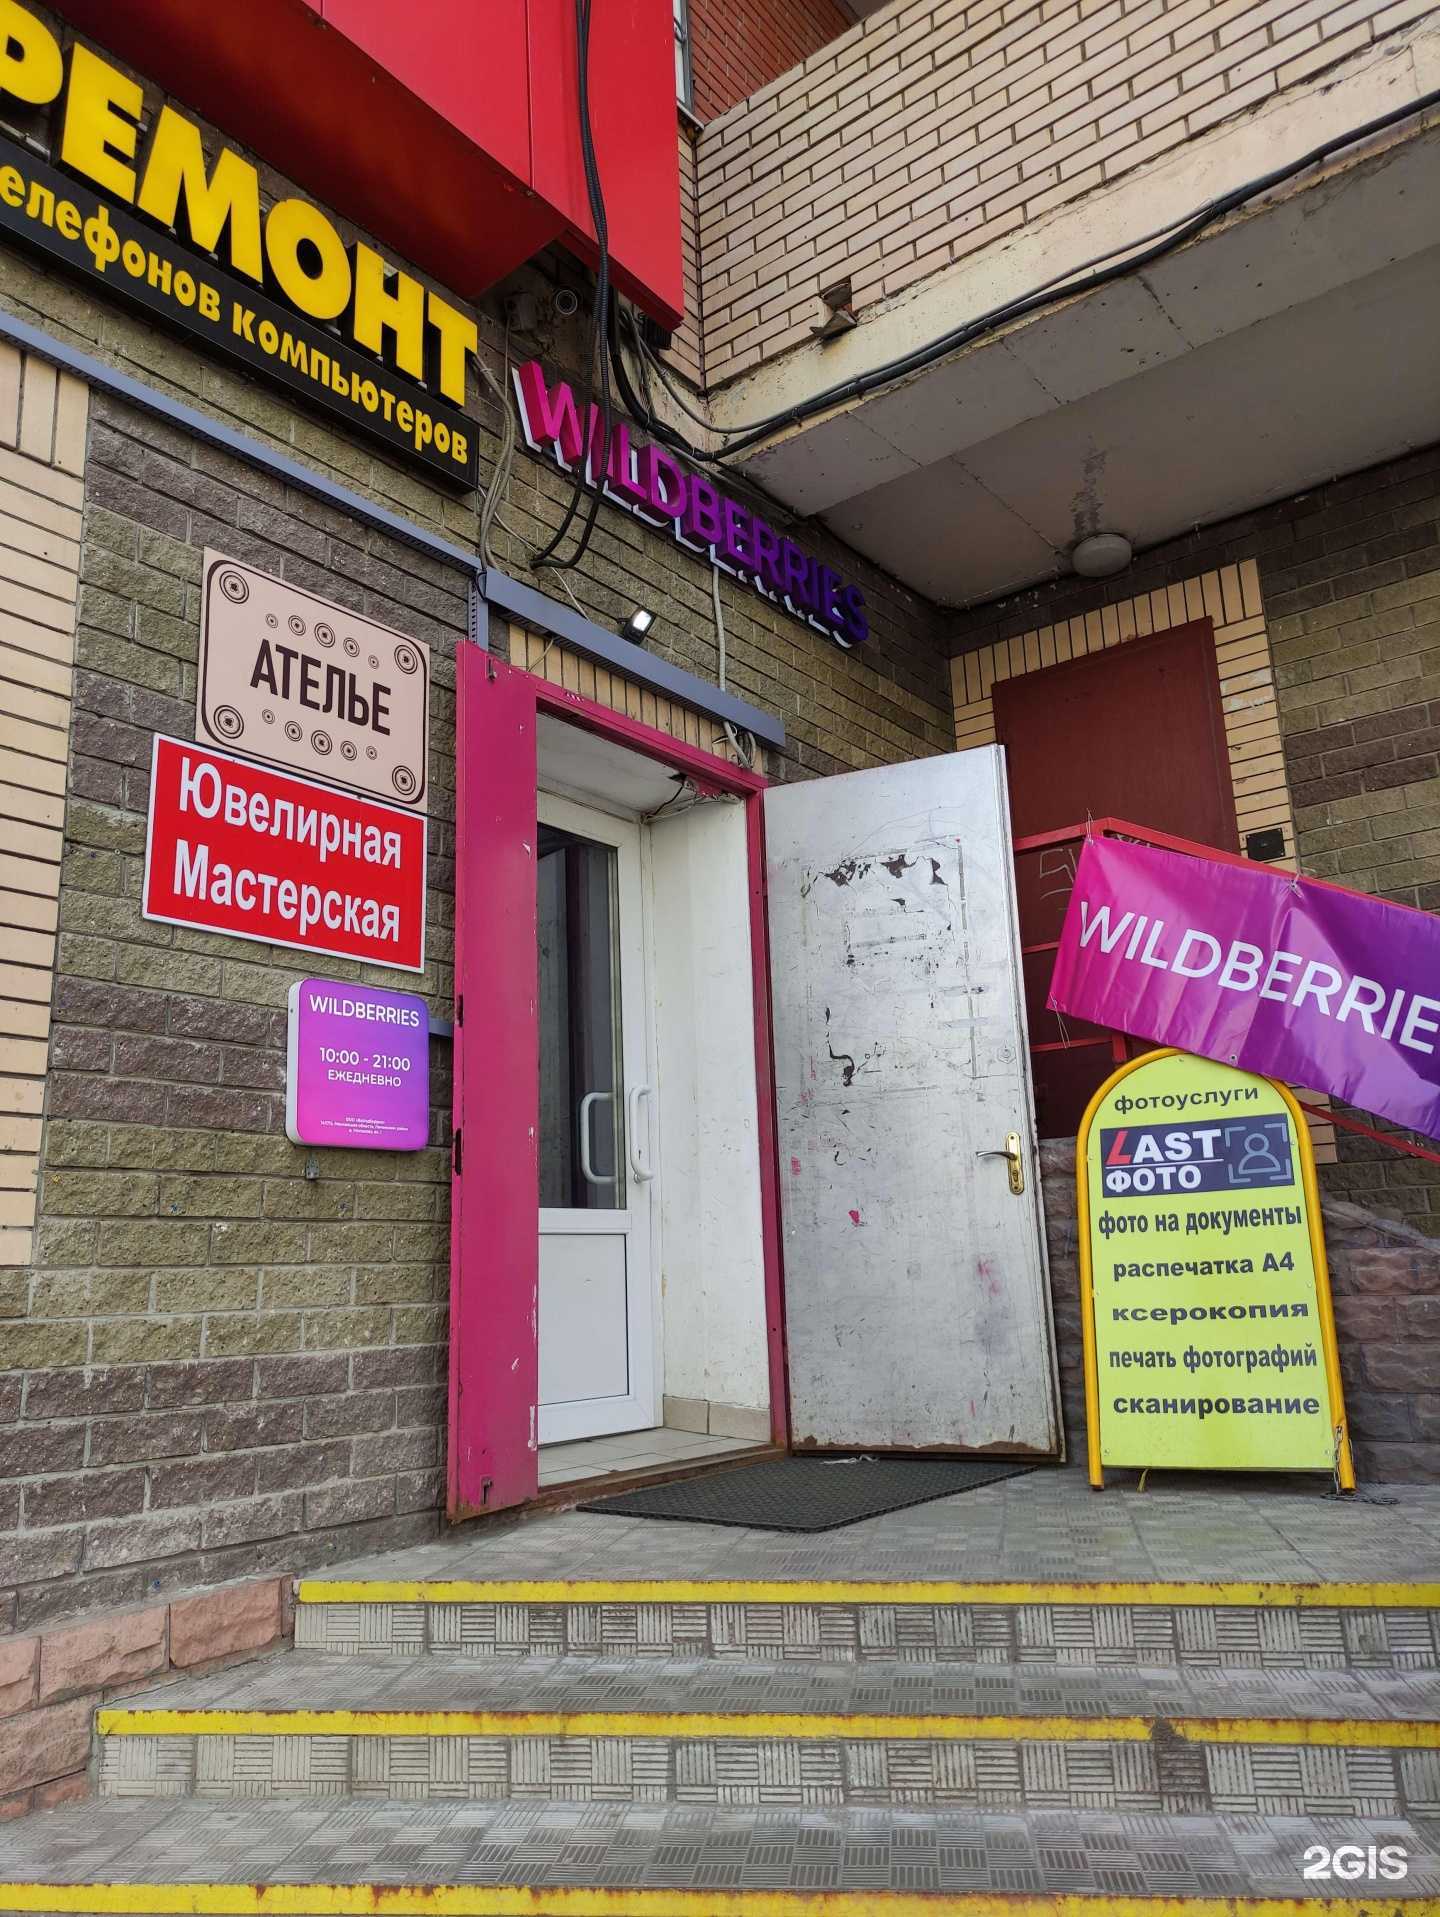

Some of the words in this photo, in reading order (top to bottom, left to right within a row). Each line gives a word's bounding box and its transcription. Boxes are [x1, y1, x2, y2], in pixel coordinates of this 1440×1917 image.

[0, 0, 477, 408] РЕМОНТ
[0, 164, 220, 316] елефонов
[232, 301, 468, 465] компьютеров
[511, 360, 869, 641] WILDBERRIES
[249, 638, 392, 736] АТЕЛЬЕ
[179, 757, 401, 869] Ювелирная
[173, 838, 400, 942] Мастерская
[309, 994, 420, 1027] WILDBERRIES
[319, 1047, 360, 1065] 10:00
[373, 1054, 411, 1071] 21:00
[328, 1069, 401, 1087] ЕЖЕДНЕВНО
[1114, 1087, 1259, 1114] фотоуслуги
[1106, 1129, 1222, 1165] LAST
[1106, 1165, 1202, 1193] ФОТО
[1099, 1210, 1149, 1239] фото
[1155, 1215, 1179, 1233] на
[1186, 1206, 1302, 1235] документы
[1113, 1258, 1253, 1281] распечатка
[1262, 1251, 1295, 1272] А4
[1112, 1303, 1309, 1325] ксерокопия
[1109, 1350, 1177, 1368] печать
[1183, 1342, 1318, 1373] фотографий
[1113, 1397, 1320, 1419] сканирование
